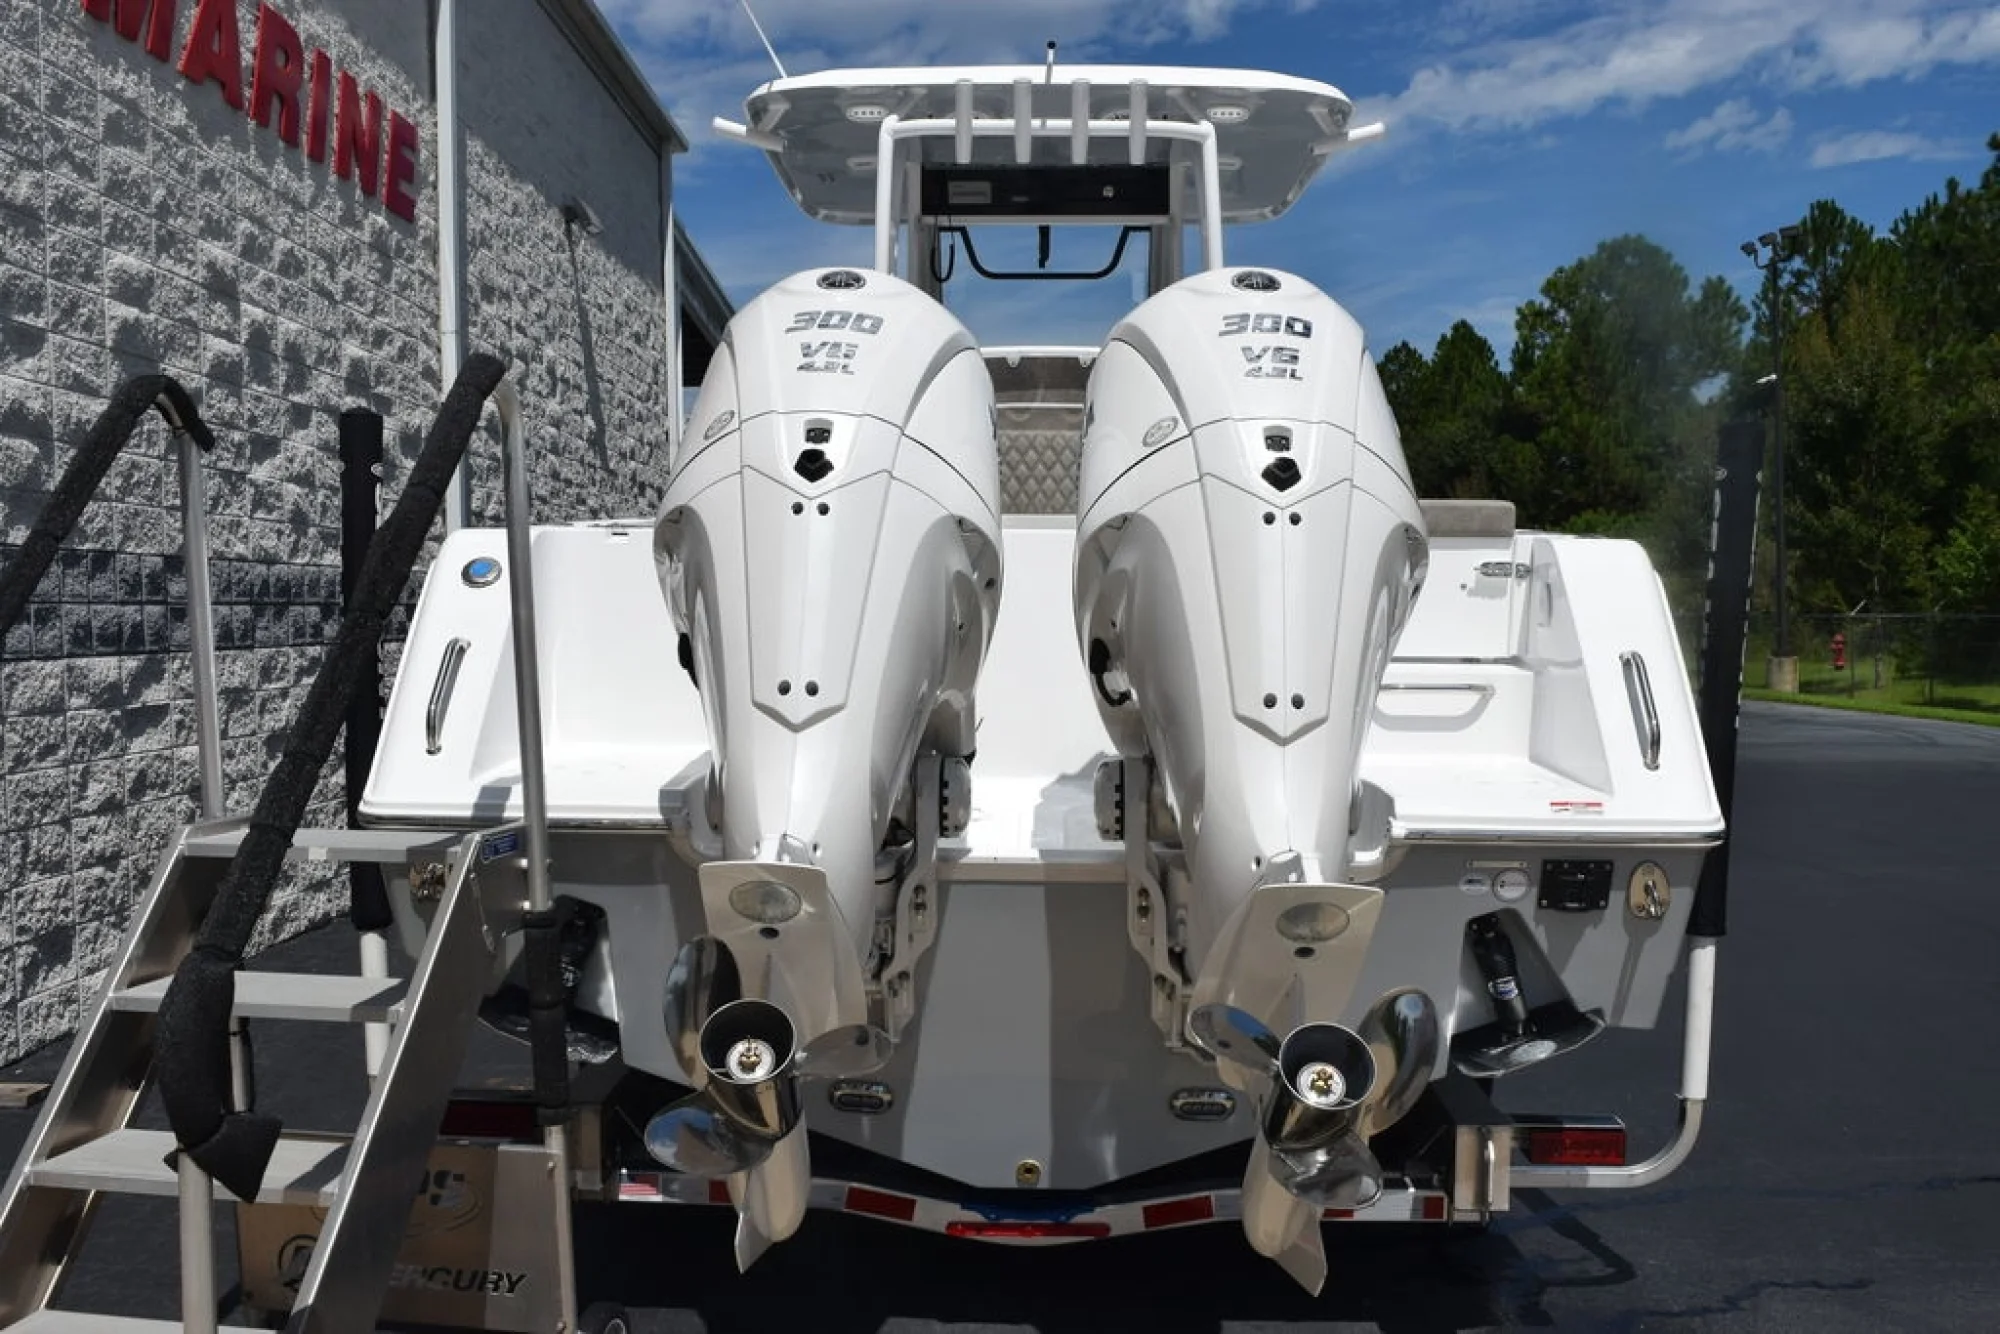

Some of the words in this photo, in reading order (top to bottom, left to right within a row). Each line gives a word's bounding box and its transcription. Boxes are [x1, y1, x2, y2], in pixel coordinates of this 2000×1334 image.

[784, 310, 883, 334] 300
[1219, 313, 1312, 338] 300
[1241, 346, 1300, 365] V6
[389, 1262, 527, 1297] ERCURY
